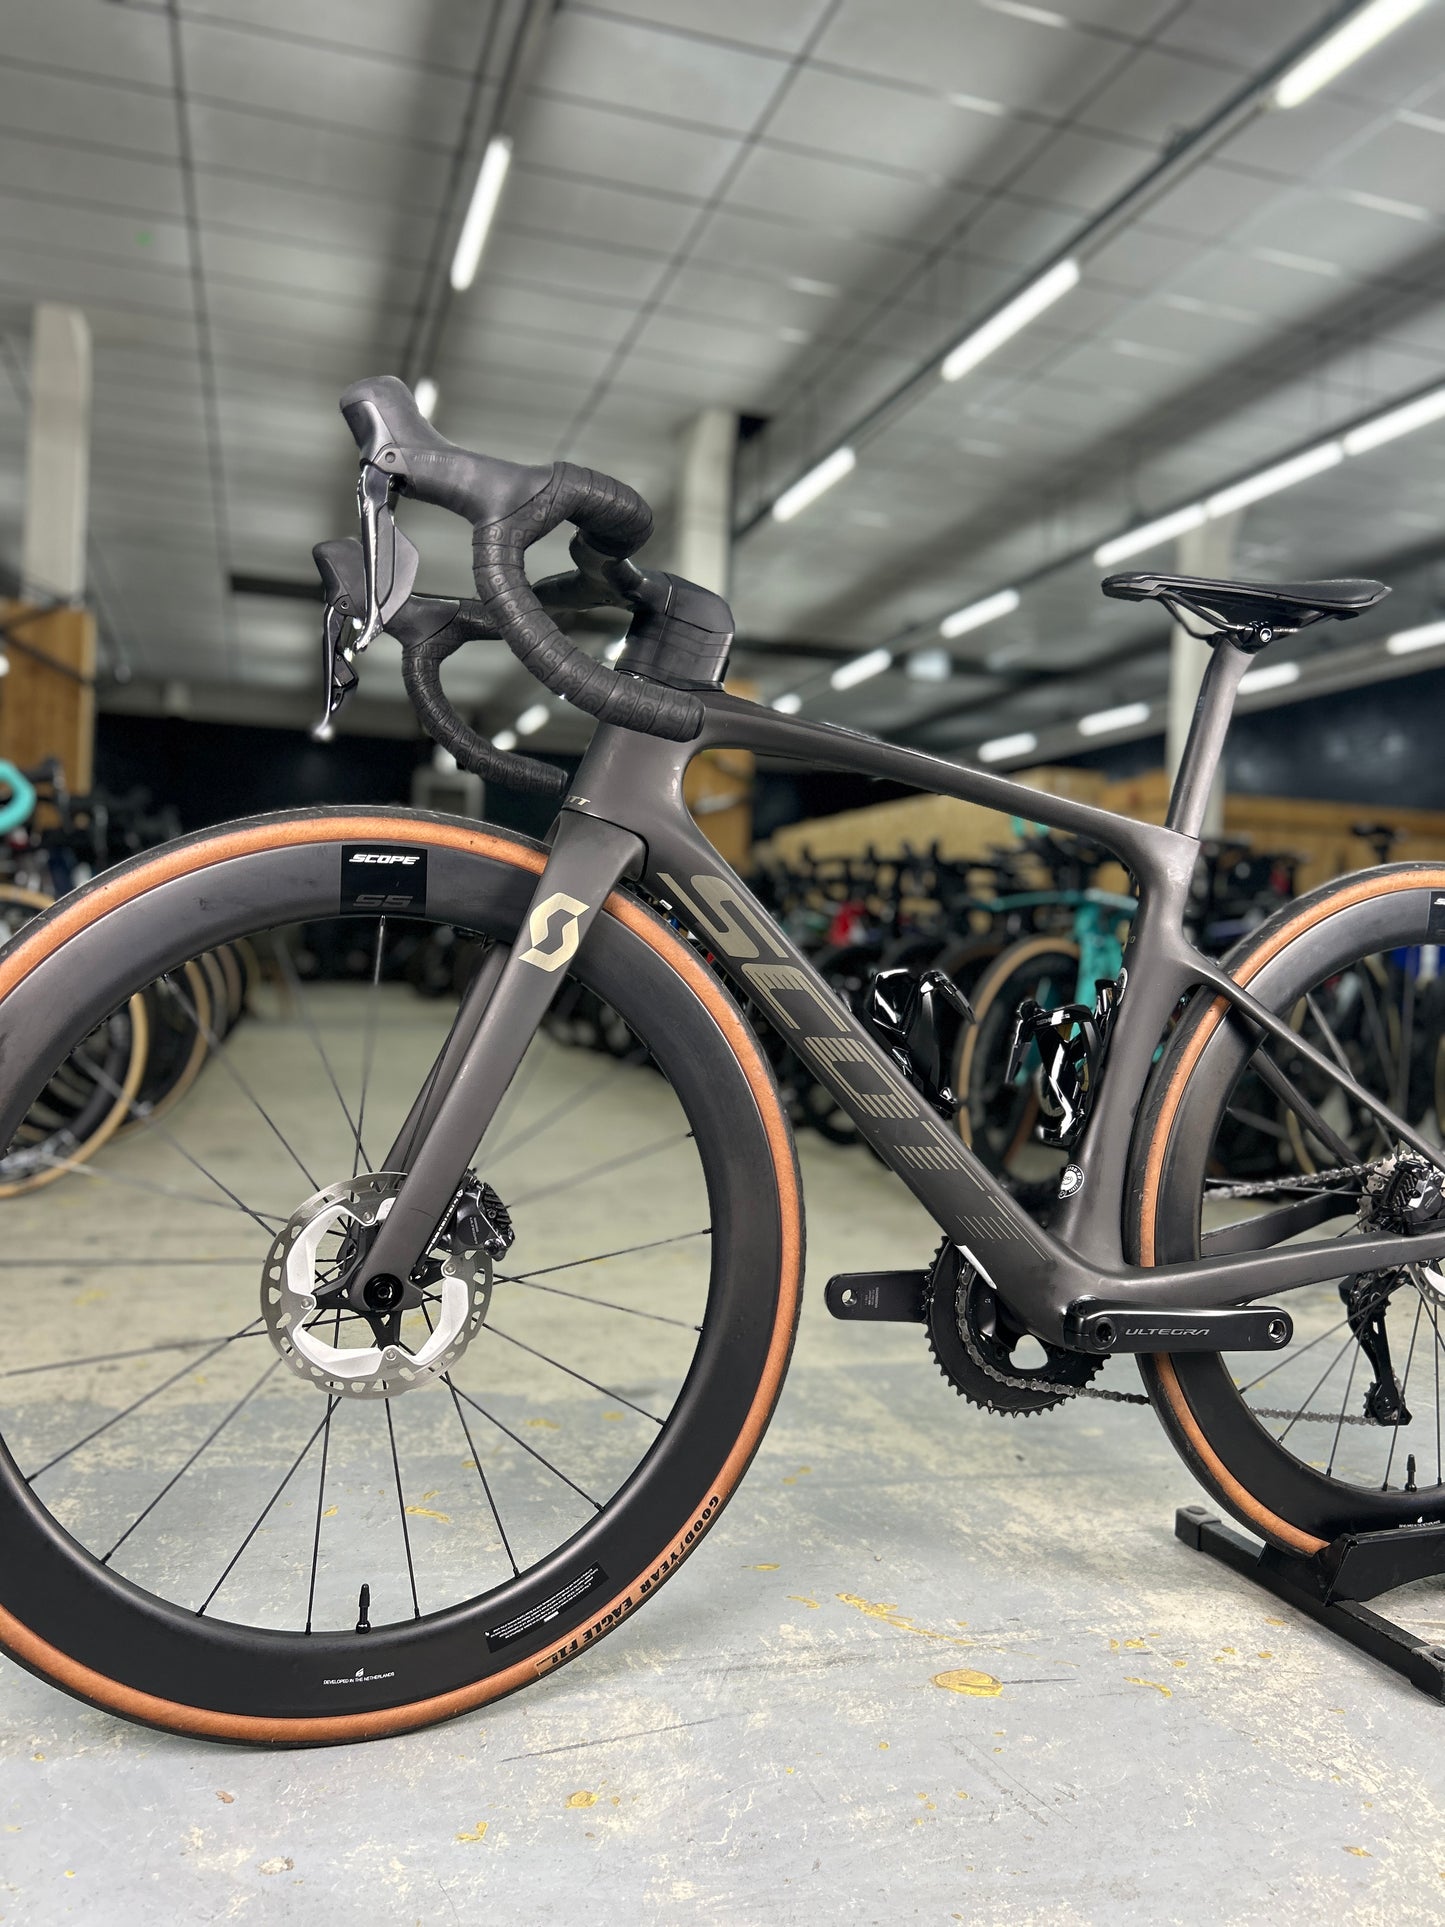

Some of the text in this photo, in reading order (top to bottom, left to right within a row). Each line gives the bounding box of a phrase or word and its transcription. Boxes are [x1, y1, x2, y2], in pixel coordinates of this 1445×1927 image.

[349, 854, 420, 865] SCOPE
[1125, 1328, 1210, 1336] ULTEGRA
[582, 1596, 634, 1643] EAGLE
[363, 1671, 395, 1682] NETHERLANDS
